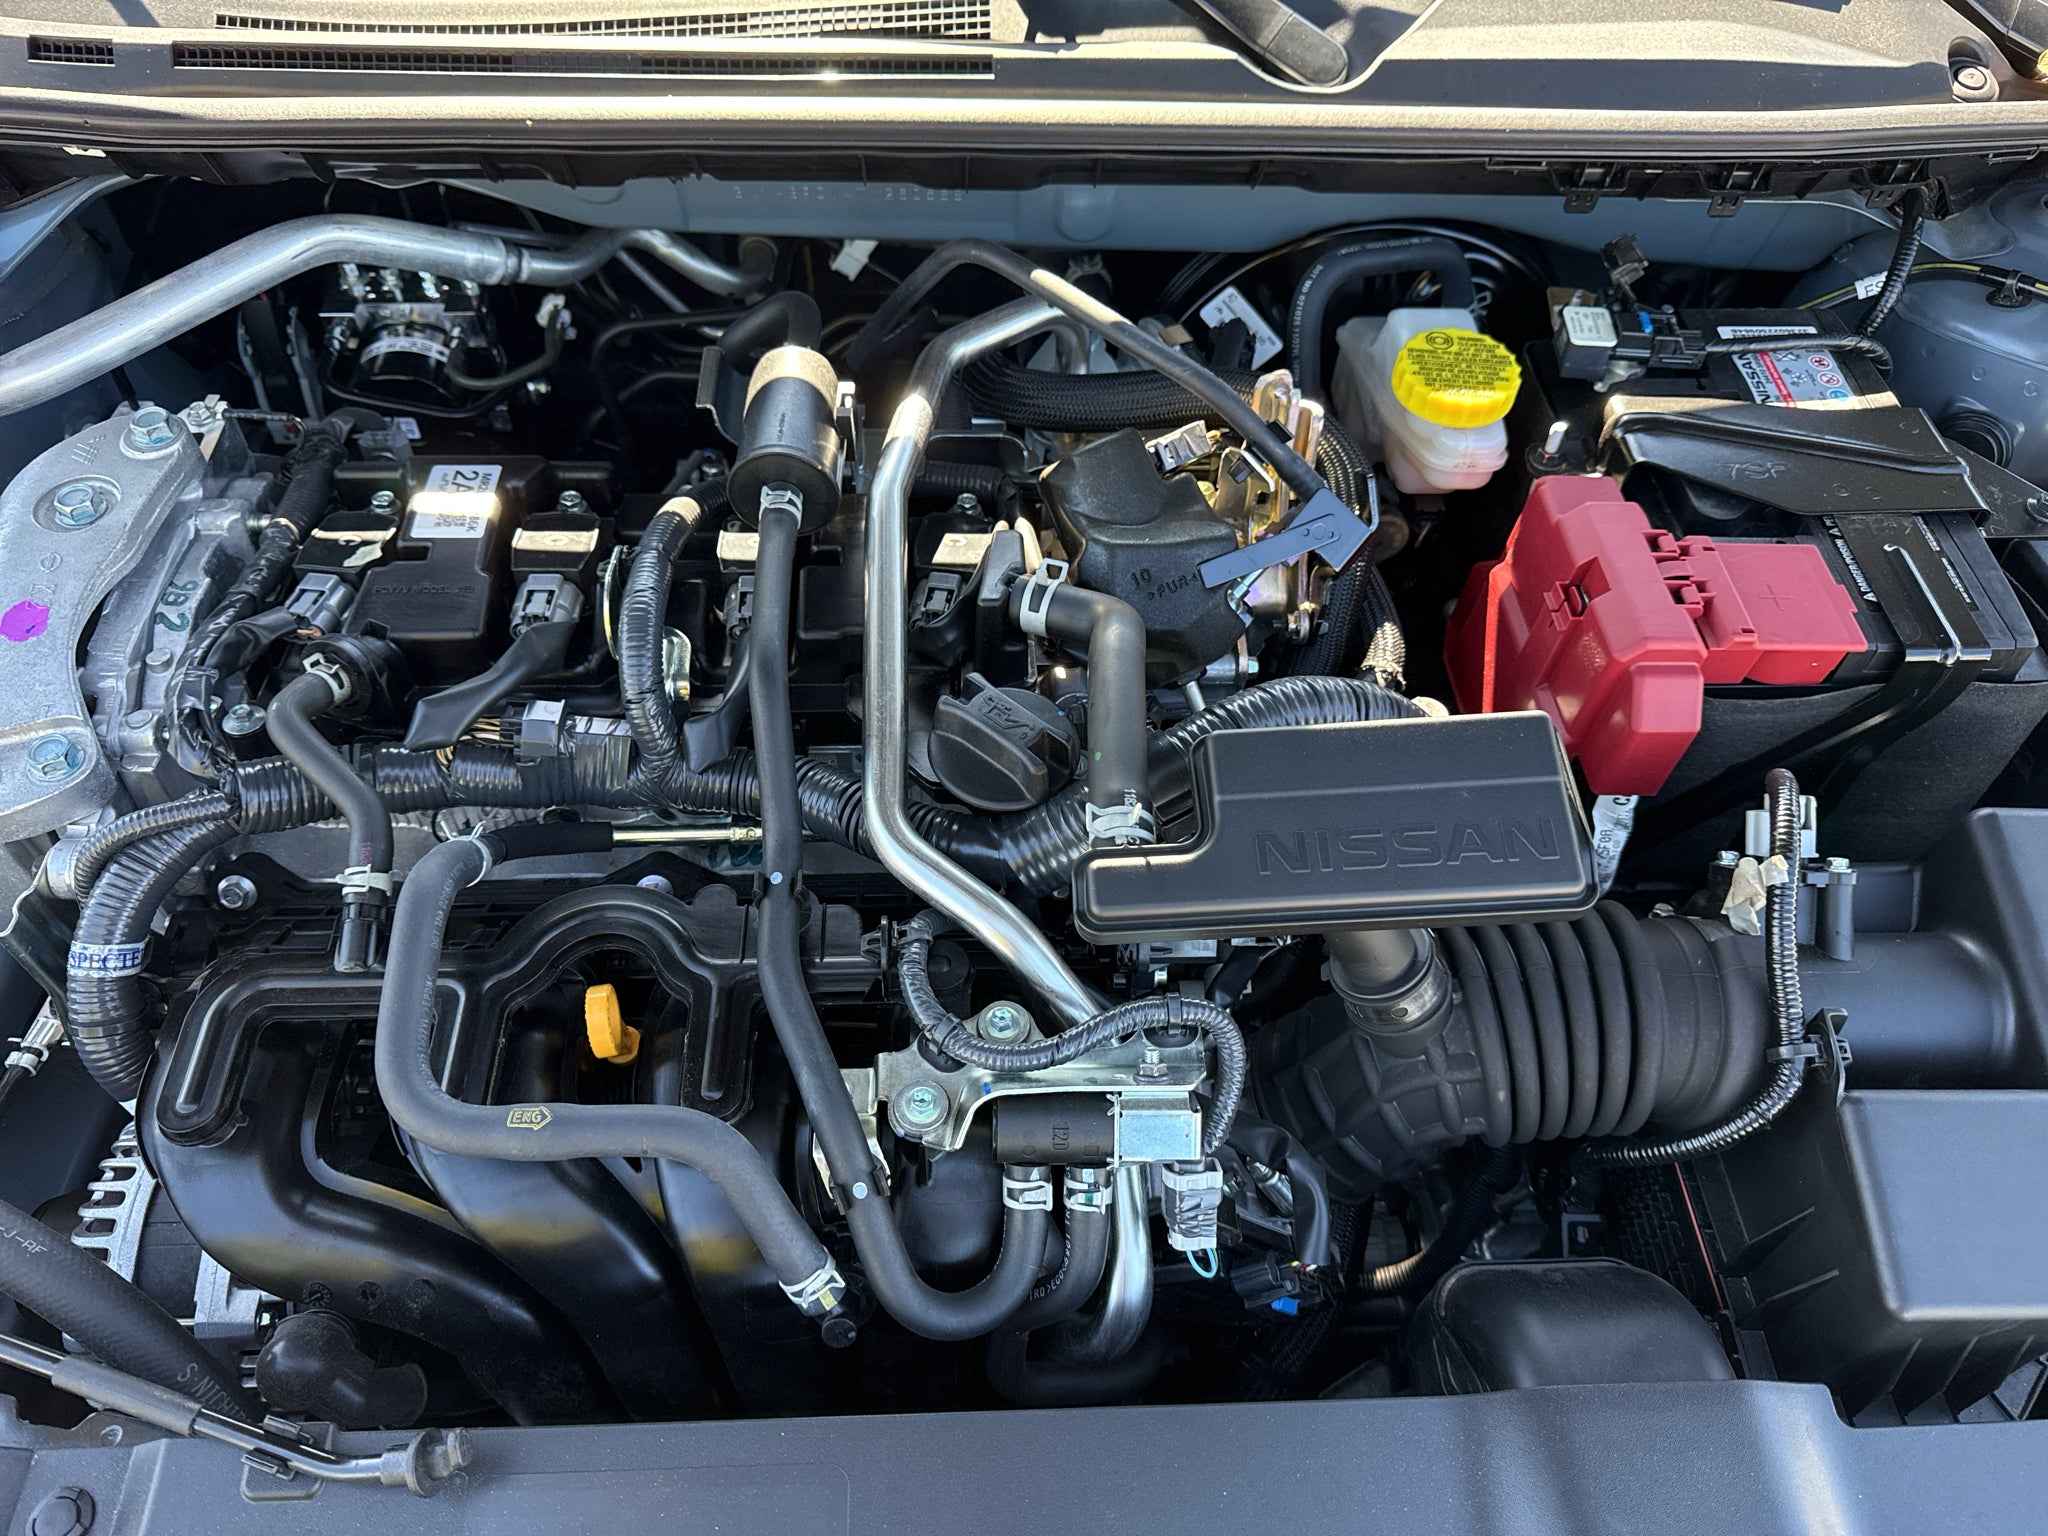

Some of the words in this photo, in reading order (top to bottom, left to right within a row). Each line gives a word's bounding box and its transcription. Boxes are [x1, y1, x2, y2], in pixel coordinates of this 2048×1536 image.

[1737, 352, 1771, 403] NISSAN
[1254, 817, 1561, 875] NISSAN
[511, 1110, 542, 1124] ENG
[1051, 1120, 1070, 1151] 120
